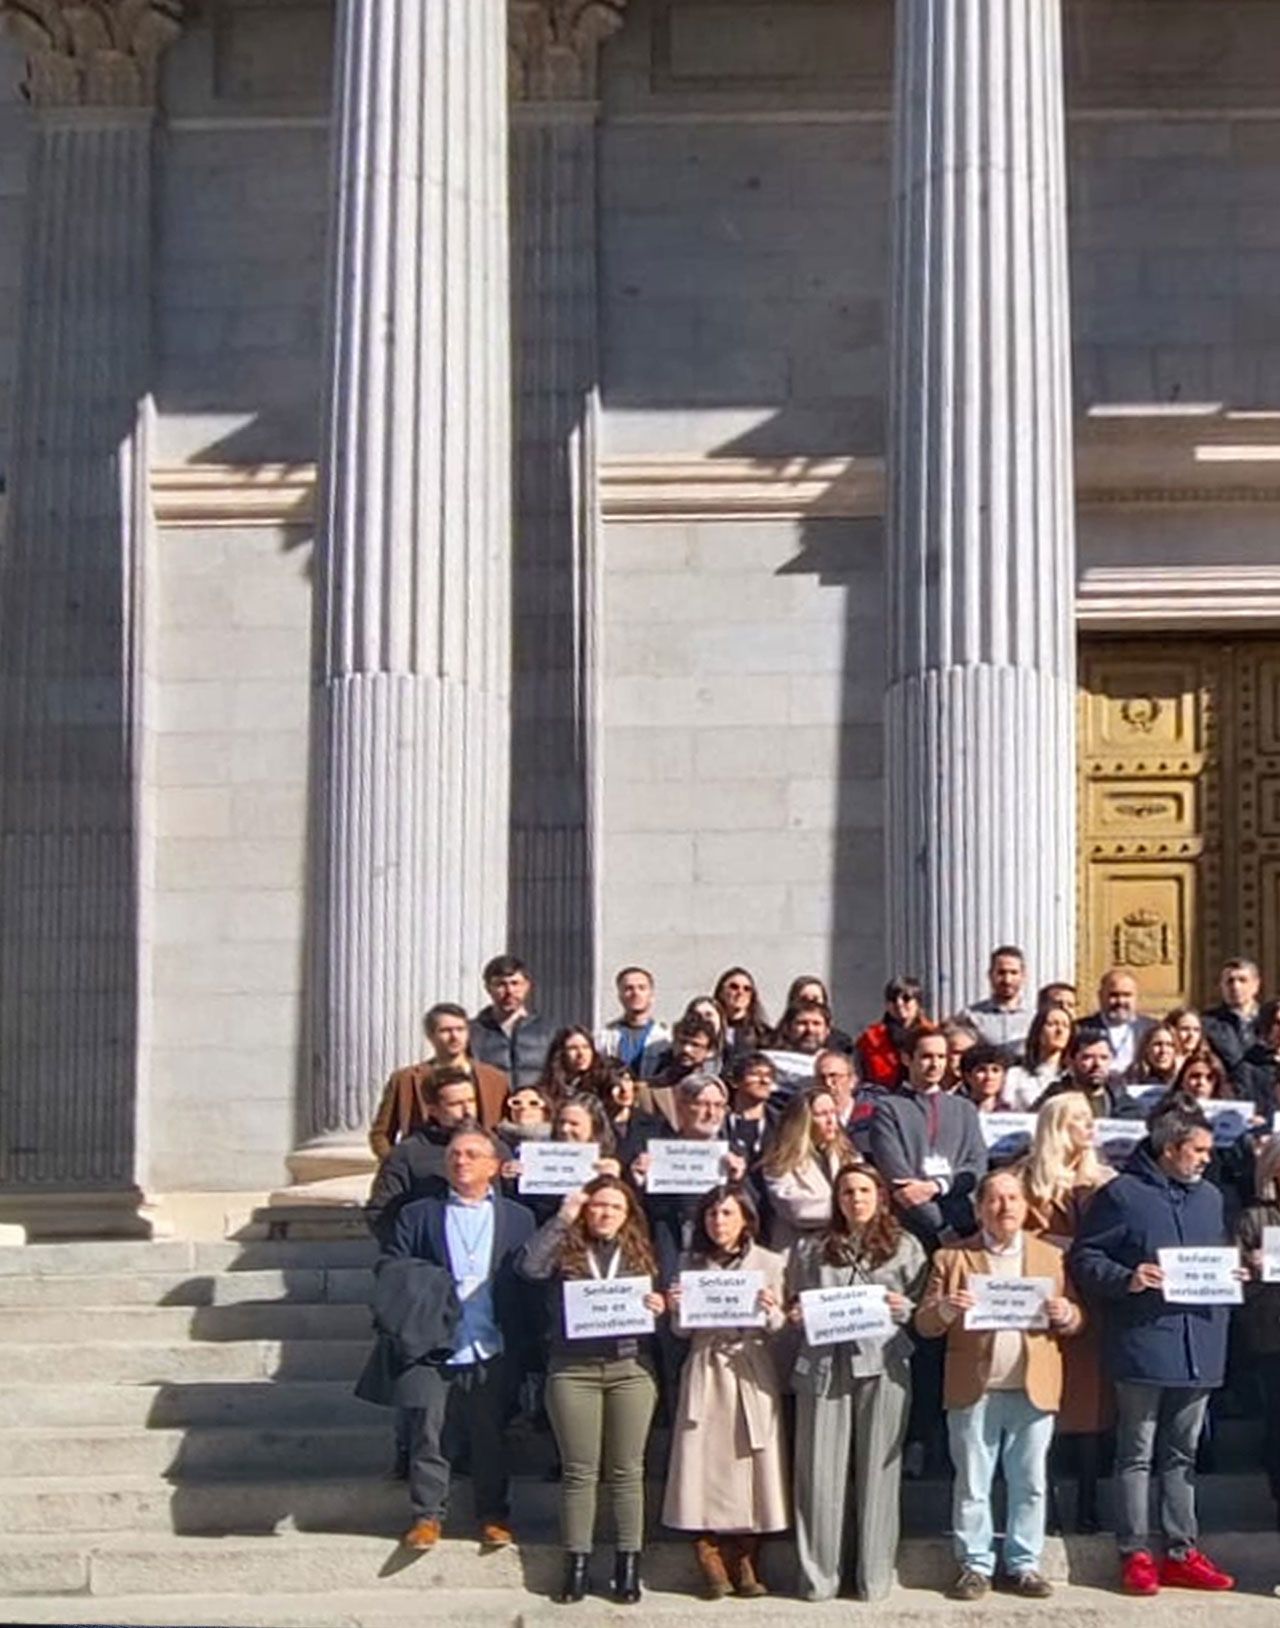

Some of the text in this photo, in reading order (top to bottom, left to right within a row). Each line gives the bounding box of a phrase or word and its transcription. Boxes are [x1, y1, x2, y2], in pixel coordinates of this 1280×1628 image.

[1177, 1252, 1222, 1263] Señalar
[1184, 1272, 1199, 1280] no
[698, 1276, 747, 1289] Señalar
[986, 1280, 1036, 1291] Señalar
[583, 1285, 633, 1298] Señalar
[819, 1290, 868, 1302] Señalar
[592, 1303, 626, 1312] no es
[829, 1306, 863, 1319] no es
